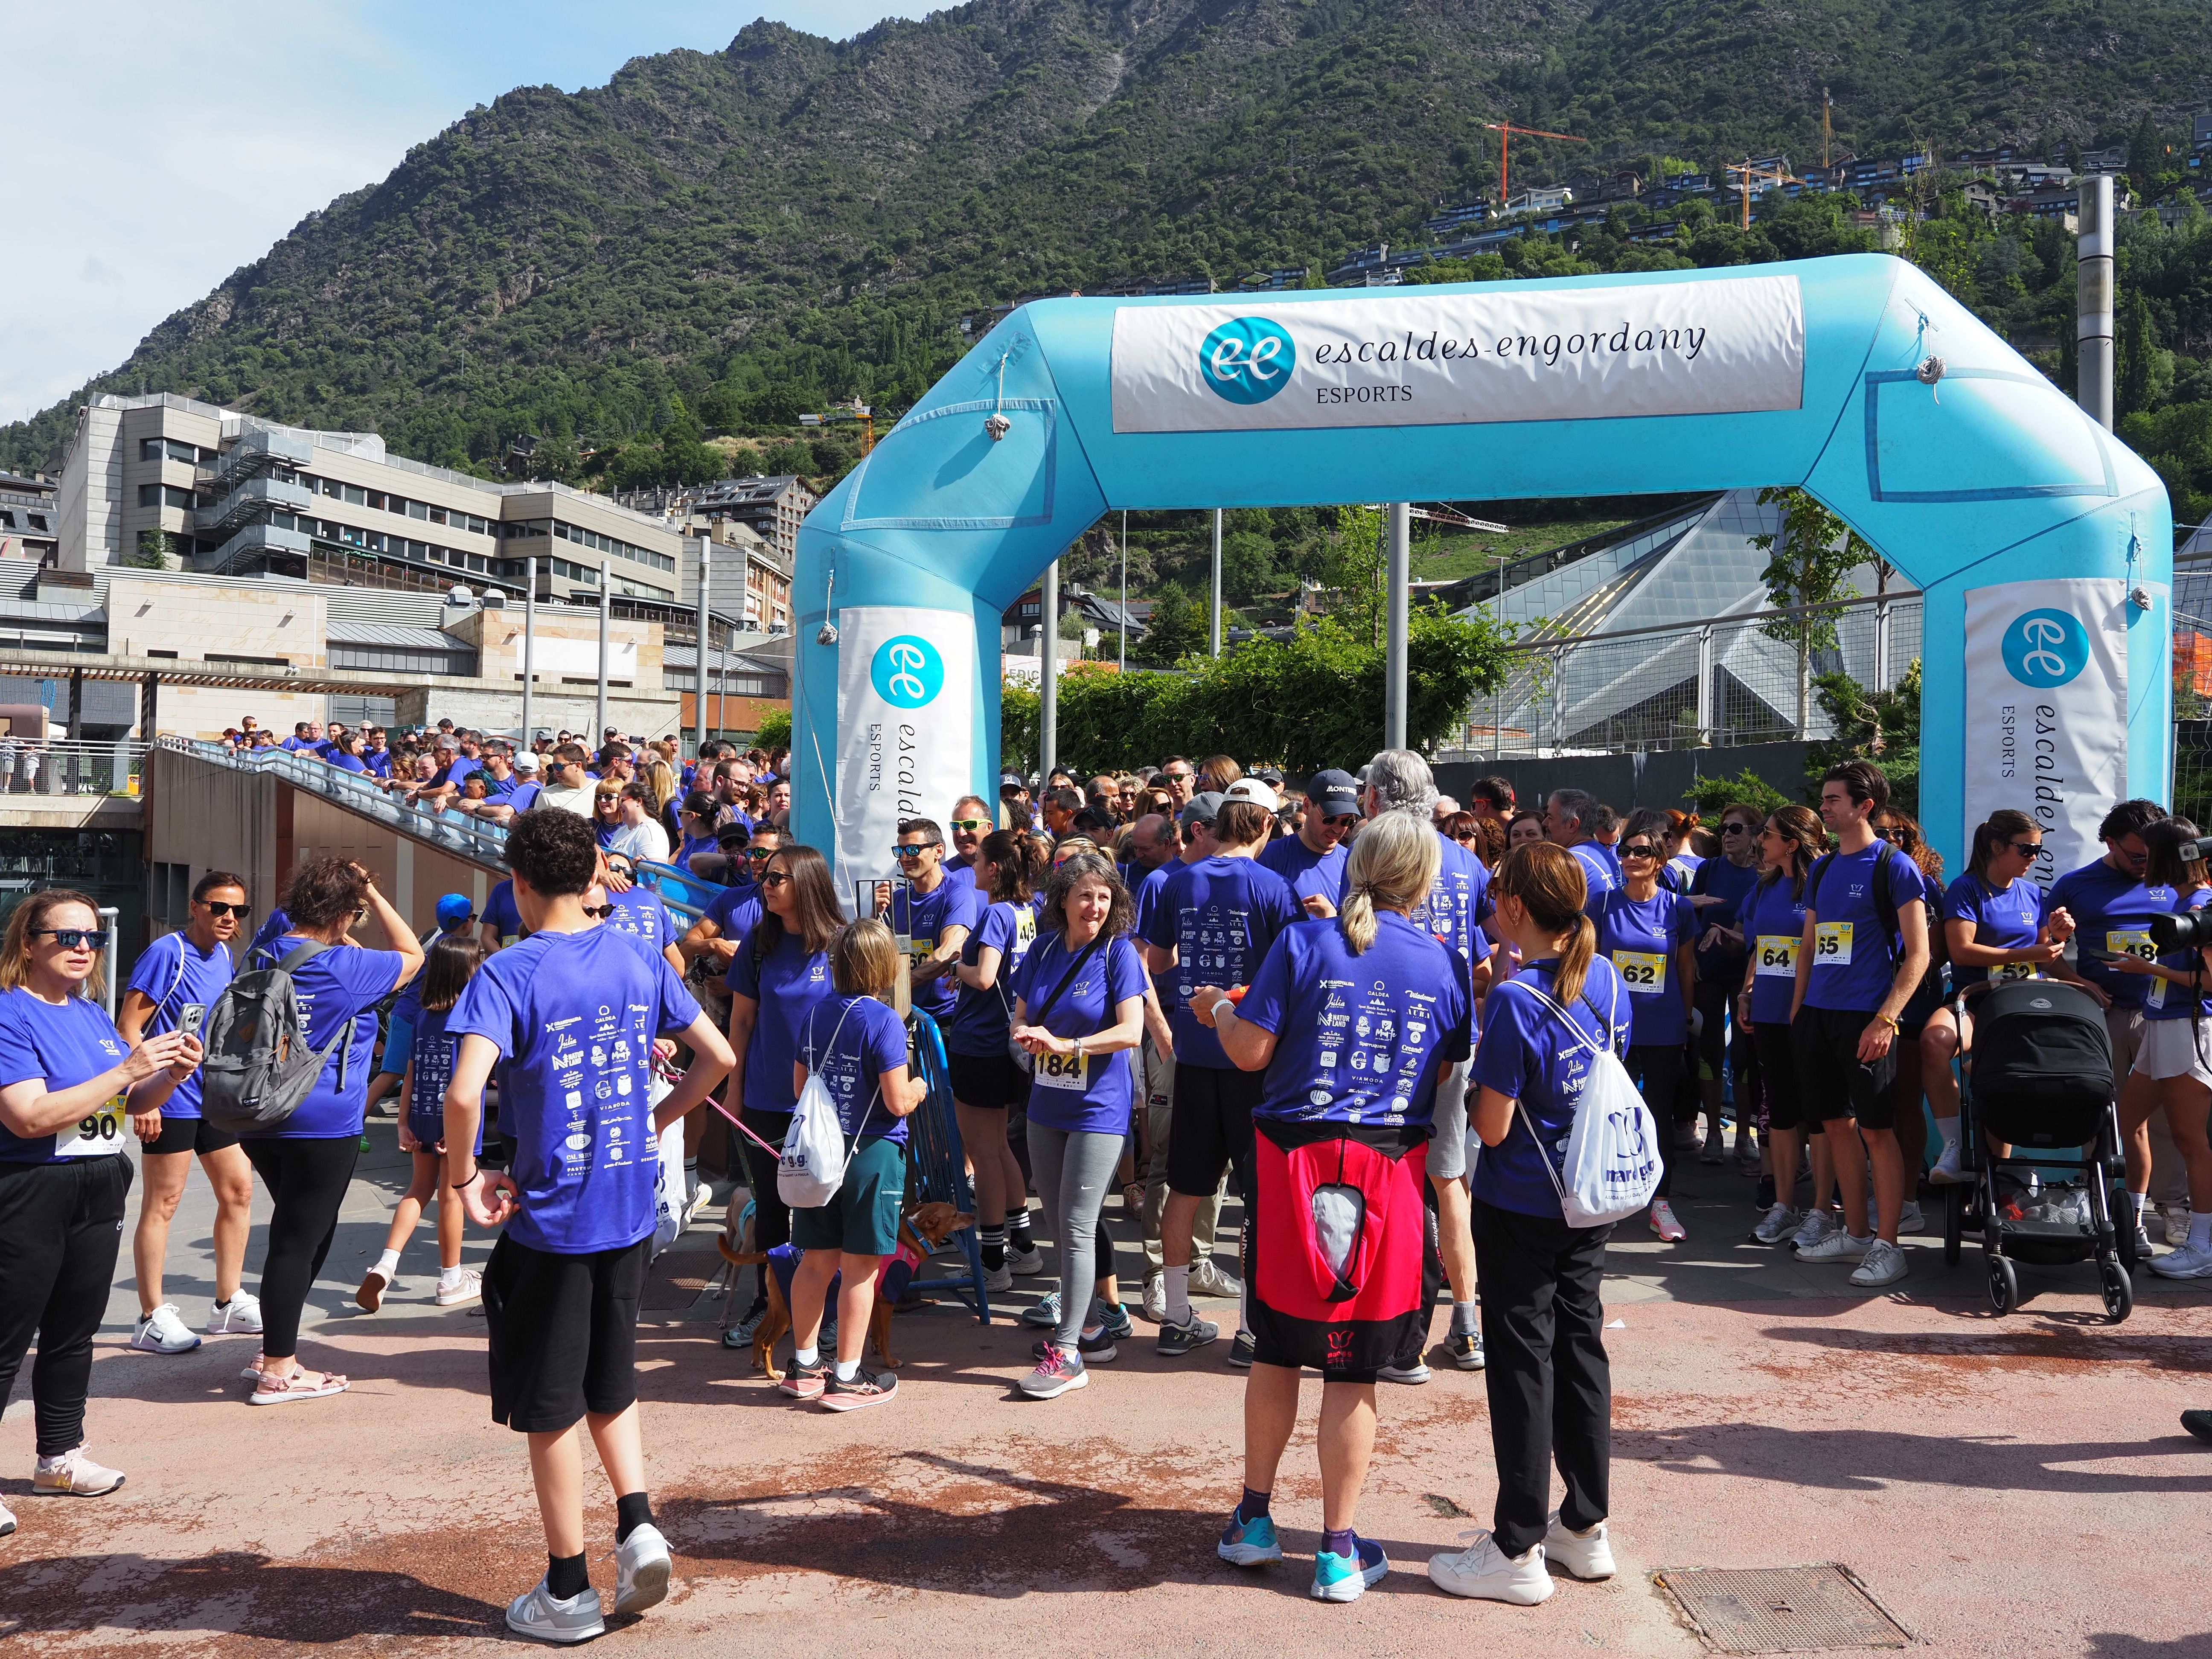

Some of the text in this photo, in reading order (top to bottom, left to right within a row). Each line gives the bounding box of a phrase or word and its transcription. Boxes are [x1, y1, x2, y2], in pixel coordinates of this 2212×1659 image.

[1316, 385, 1412, 404] ESPORTS
[2002, 705, 2015, 778] ESPORTS
[870, 724, 882, 791] ESPORTS
[1819, 936, 1839, 955] 65
[1763, 948, 1790, 967] 64
[1623, 965, 1655, 984] 62
[595, 1015, 616, 1023] CALDEA
[1333, 1014, 1350, 1022] NATUR
[1039, 1052, 1082, 1079] 184
[1352, 1076, 1383, 1084] VIAMODA
[79, 1114, 117, 1141] 90
